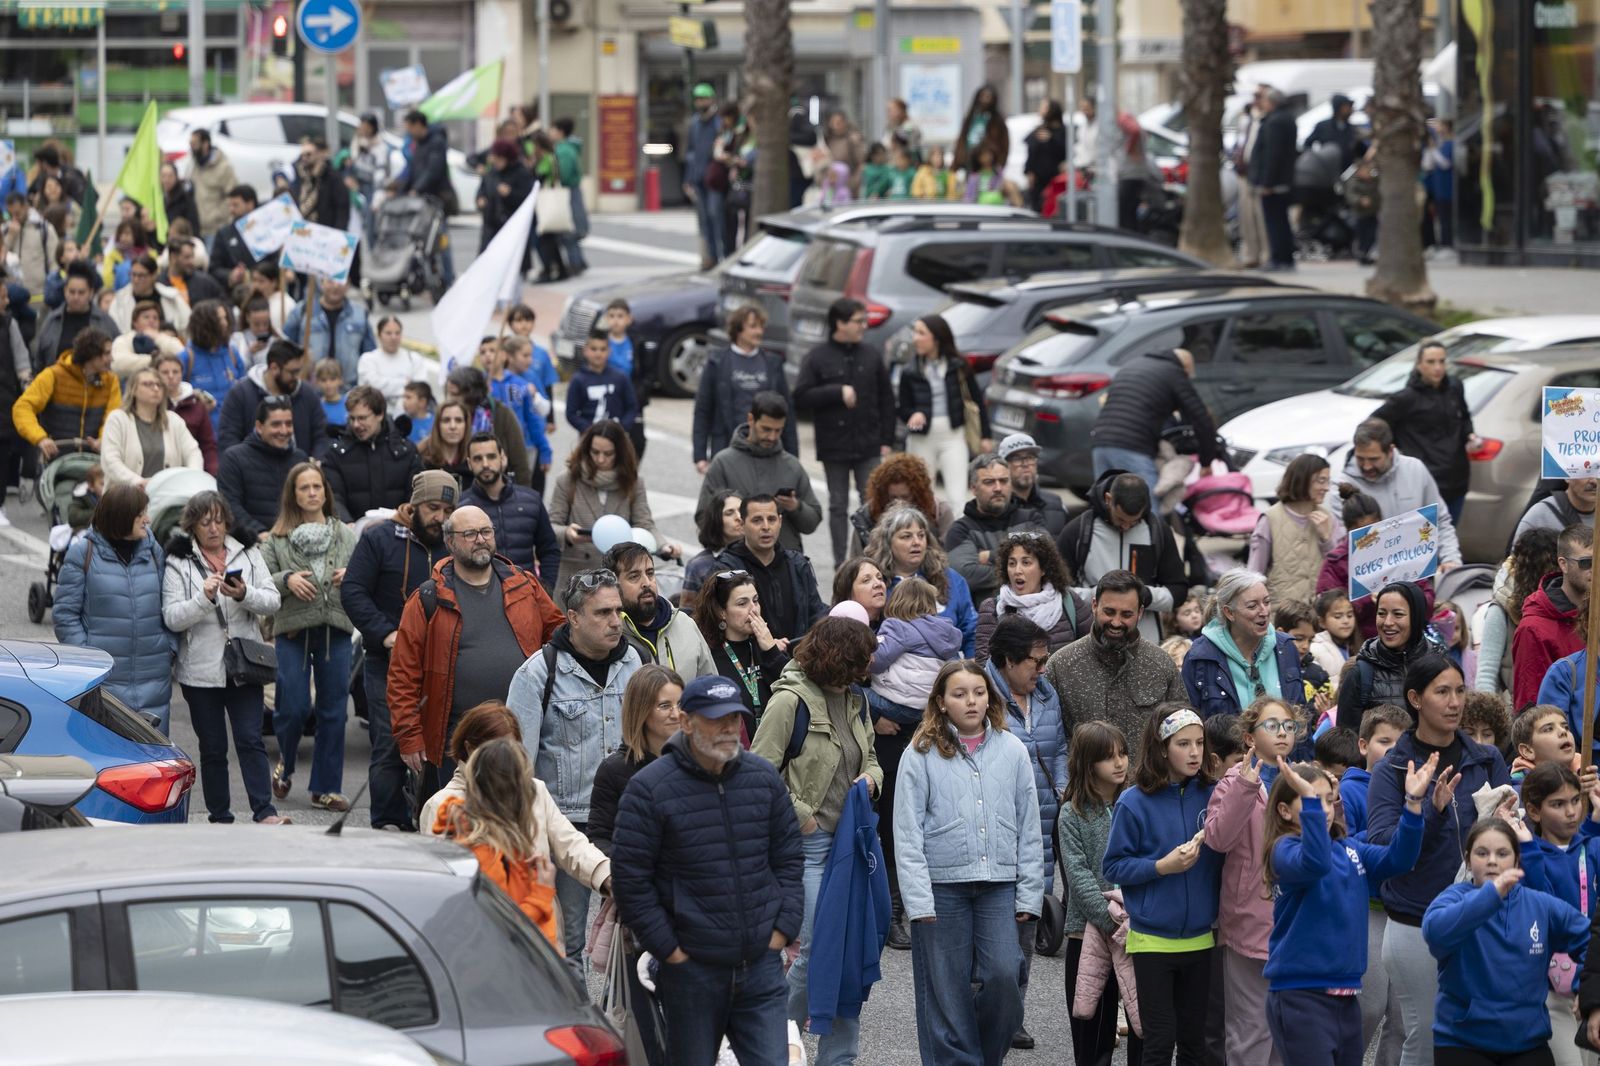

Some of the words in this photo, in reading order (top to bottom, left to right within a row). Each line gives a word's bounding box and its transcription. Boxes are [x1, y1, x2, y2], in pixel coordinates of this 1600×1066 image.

[1558, 442, 1598, 456] TIERNO
[1384, 535, 1401, 549] CEIP
[1355, 557, 1384, 576] REYES
